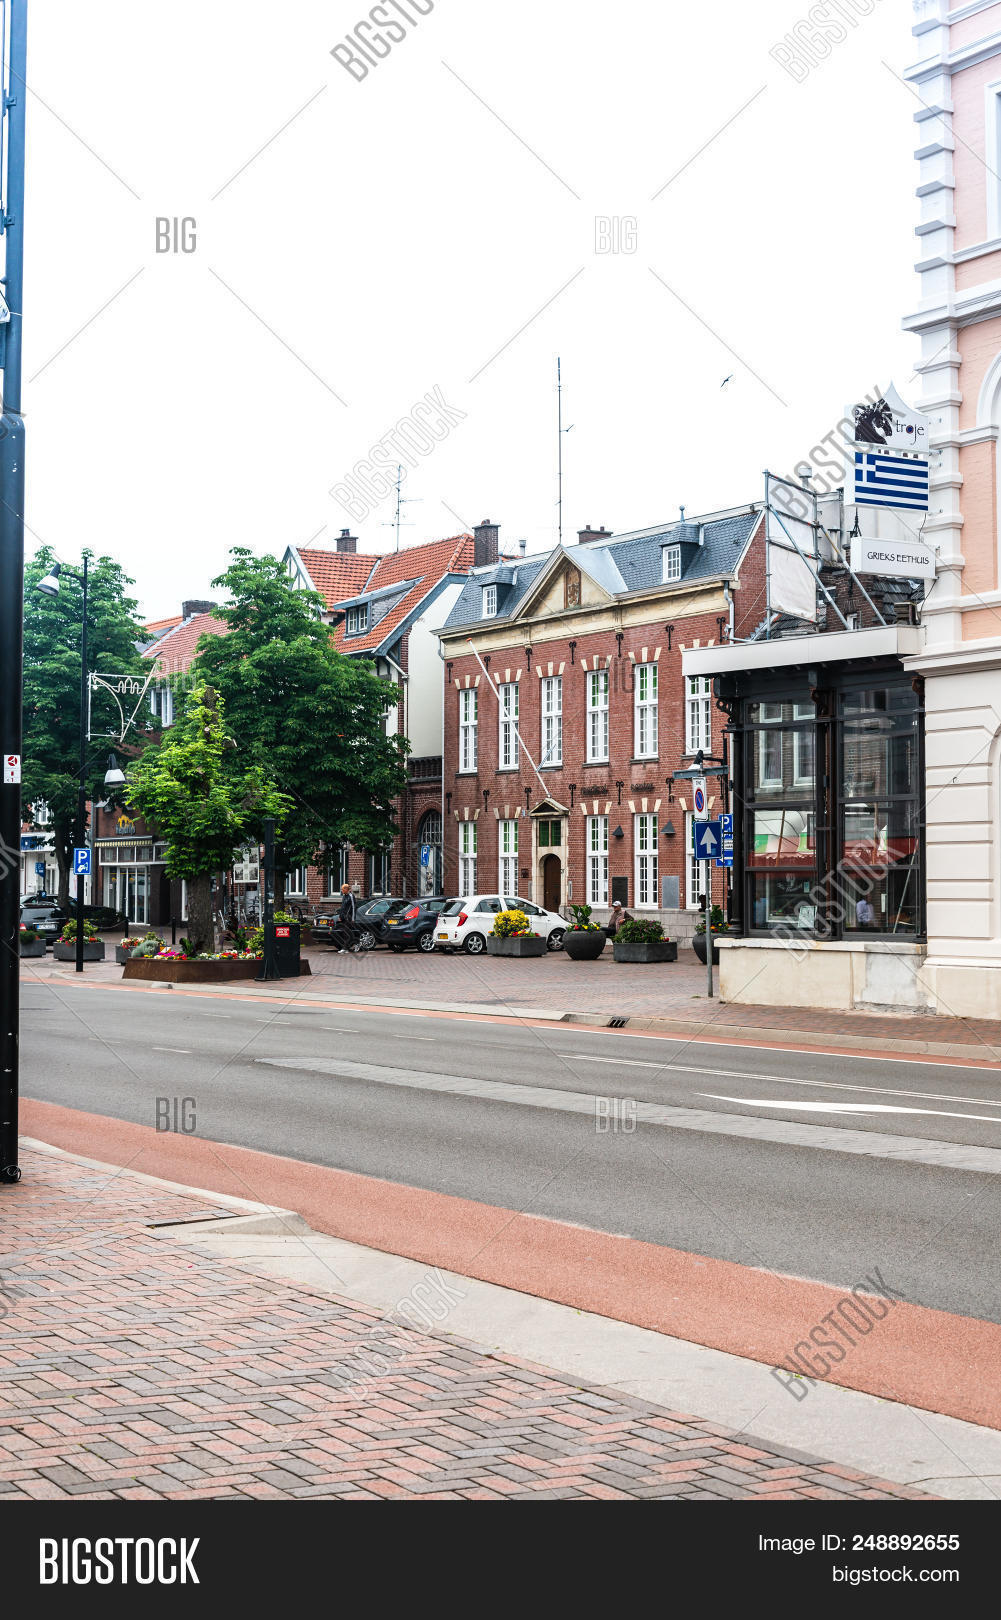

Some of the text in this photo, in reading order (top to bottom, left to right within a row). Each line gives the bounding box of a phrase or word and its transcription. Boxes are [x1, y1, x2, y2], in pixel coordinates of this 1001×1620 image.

[896, 419, 925, 445] troje
[867, 551, 930, 565] GRIEKS EETHUIS
[78, 850, 88, 864] P
[423, 847, 428, 858] P
